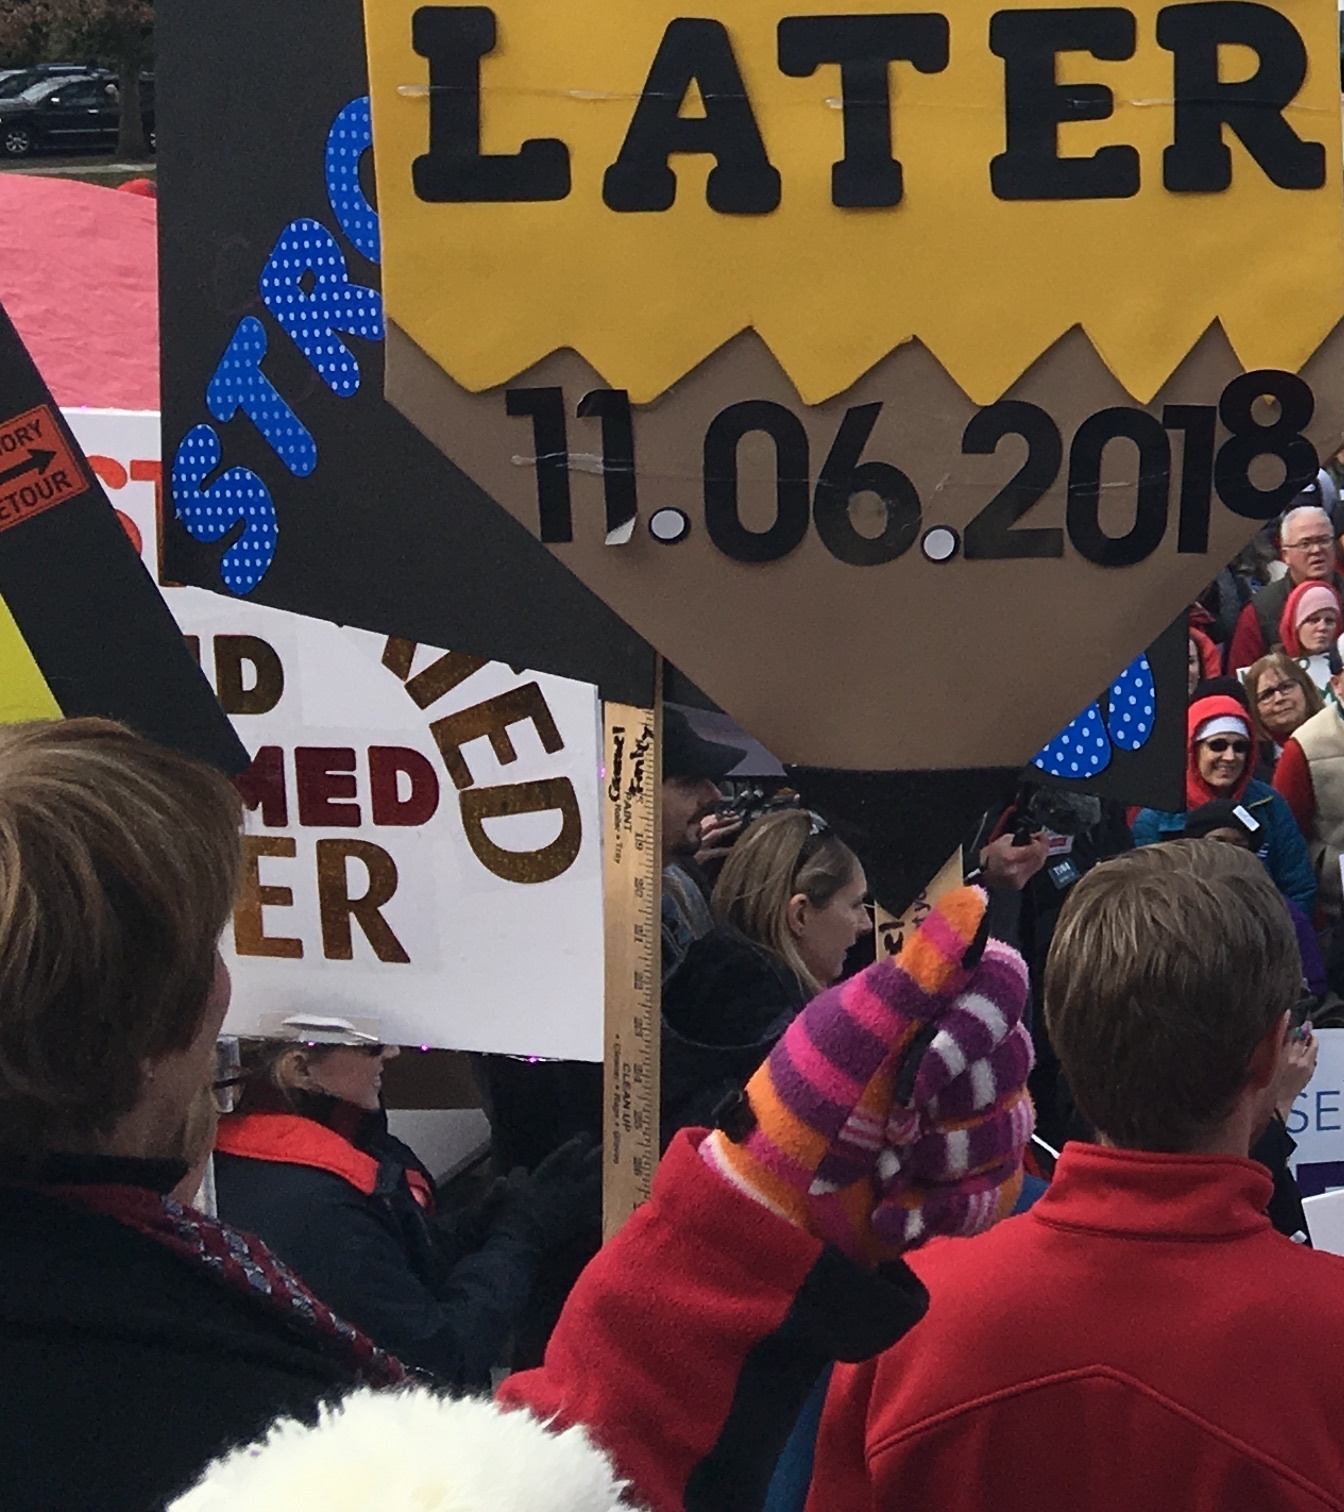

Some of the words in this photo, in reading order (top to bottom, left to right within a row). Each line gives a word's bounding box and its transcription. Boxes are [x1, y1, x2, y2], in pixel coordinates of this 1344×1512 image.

[411, 0, 1327, 215] LATER
[0, 419, 43, 457] ORY
[505, 369, 1321, 568] 11.06.2018
[622, 1063, 632, 1110] CLEAN
[622, 1113, 632, 1133] UP
